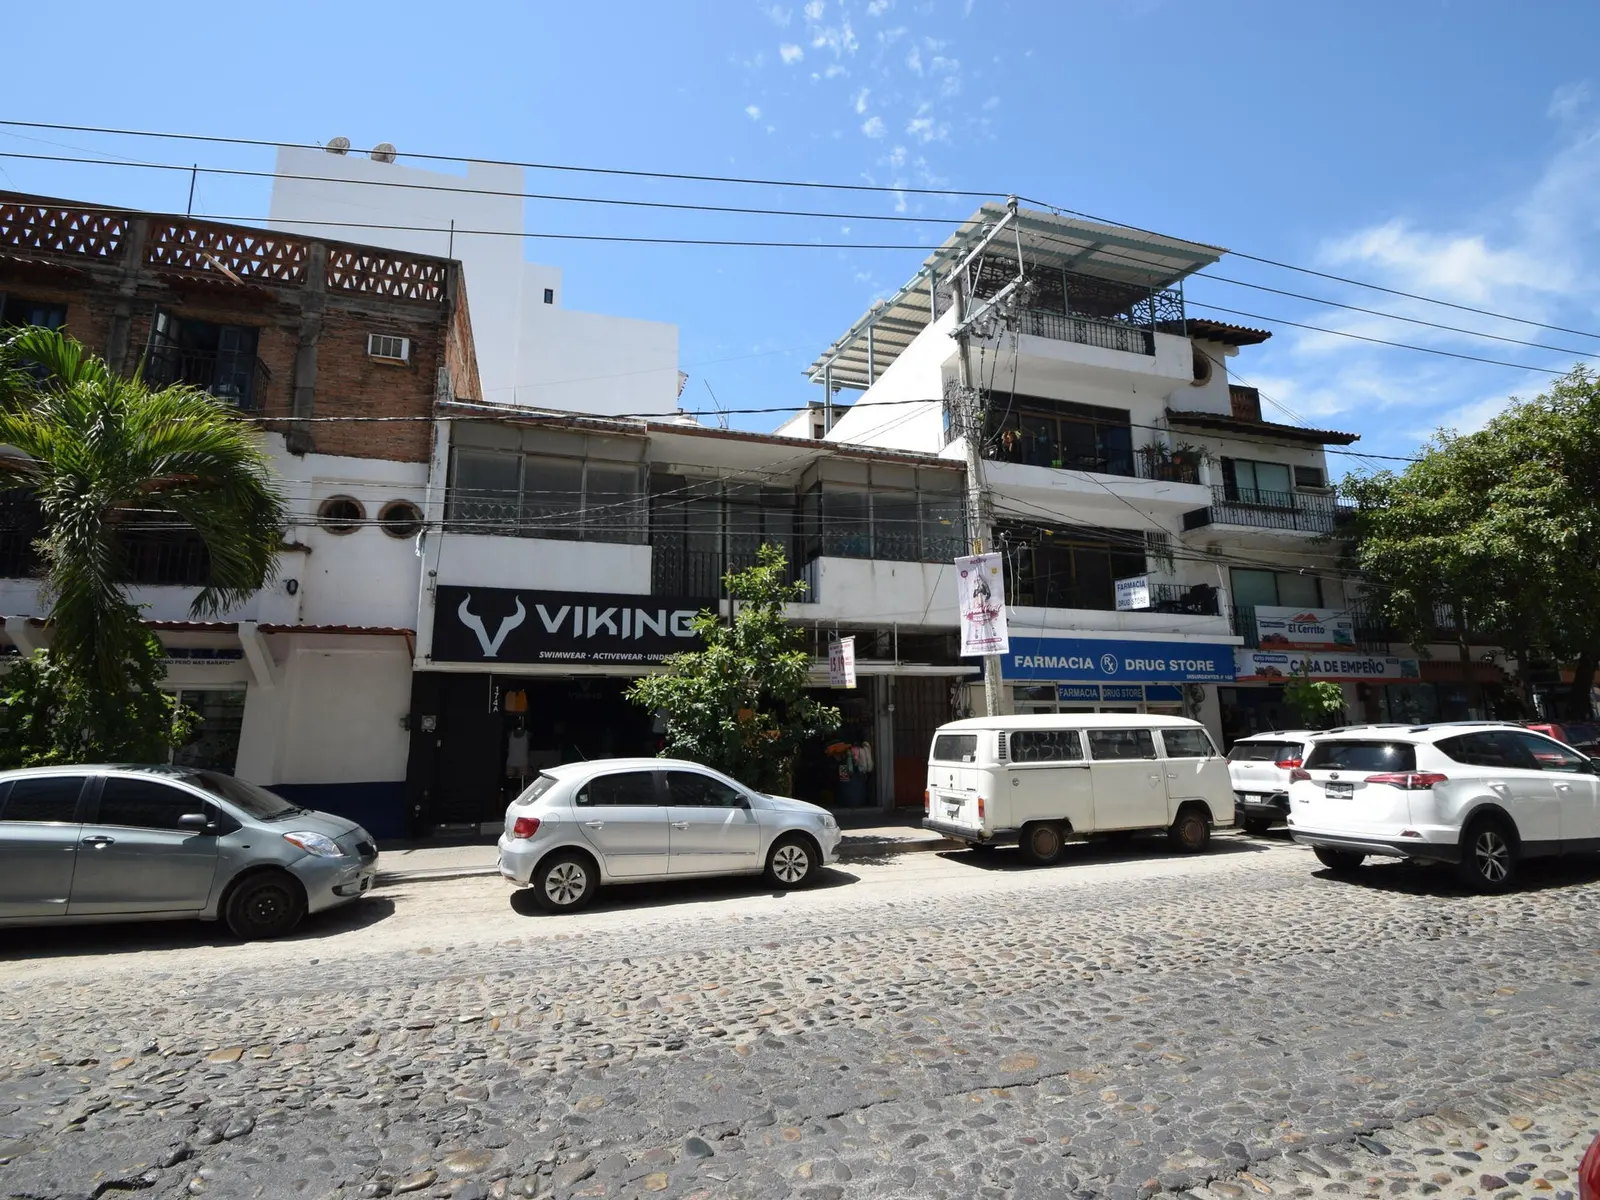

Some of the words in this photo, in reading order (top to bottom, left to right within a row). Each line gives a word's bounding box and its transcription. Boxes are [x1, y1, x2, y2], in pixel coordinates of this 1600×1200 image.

[1117, 580, 1145, 592] FARMACIA
[535, 604, 699, 640] VIKING
[1288, 624, 1296, 633] El
[1298, 624, 1325, 634] Cerrito
[539, 651, 586, 659] SWIMWEAR
[592, 652, 642, 661] ACTIVEWEAR
[1014, 655, 1095, 670] FARMACIA
[1125, 658, 1165, 671] DRUG
[1169, 660, 1215, 672] STORE
[1324, 661, 1338, 673] DE
[1340, 658, 1385, 674] EMPEÑO
[1060, 687, 1098, 697] FARMACIA
[1102, 688, 1120, 698] DRUG
[1121, 689, 1142, 698] STORE
